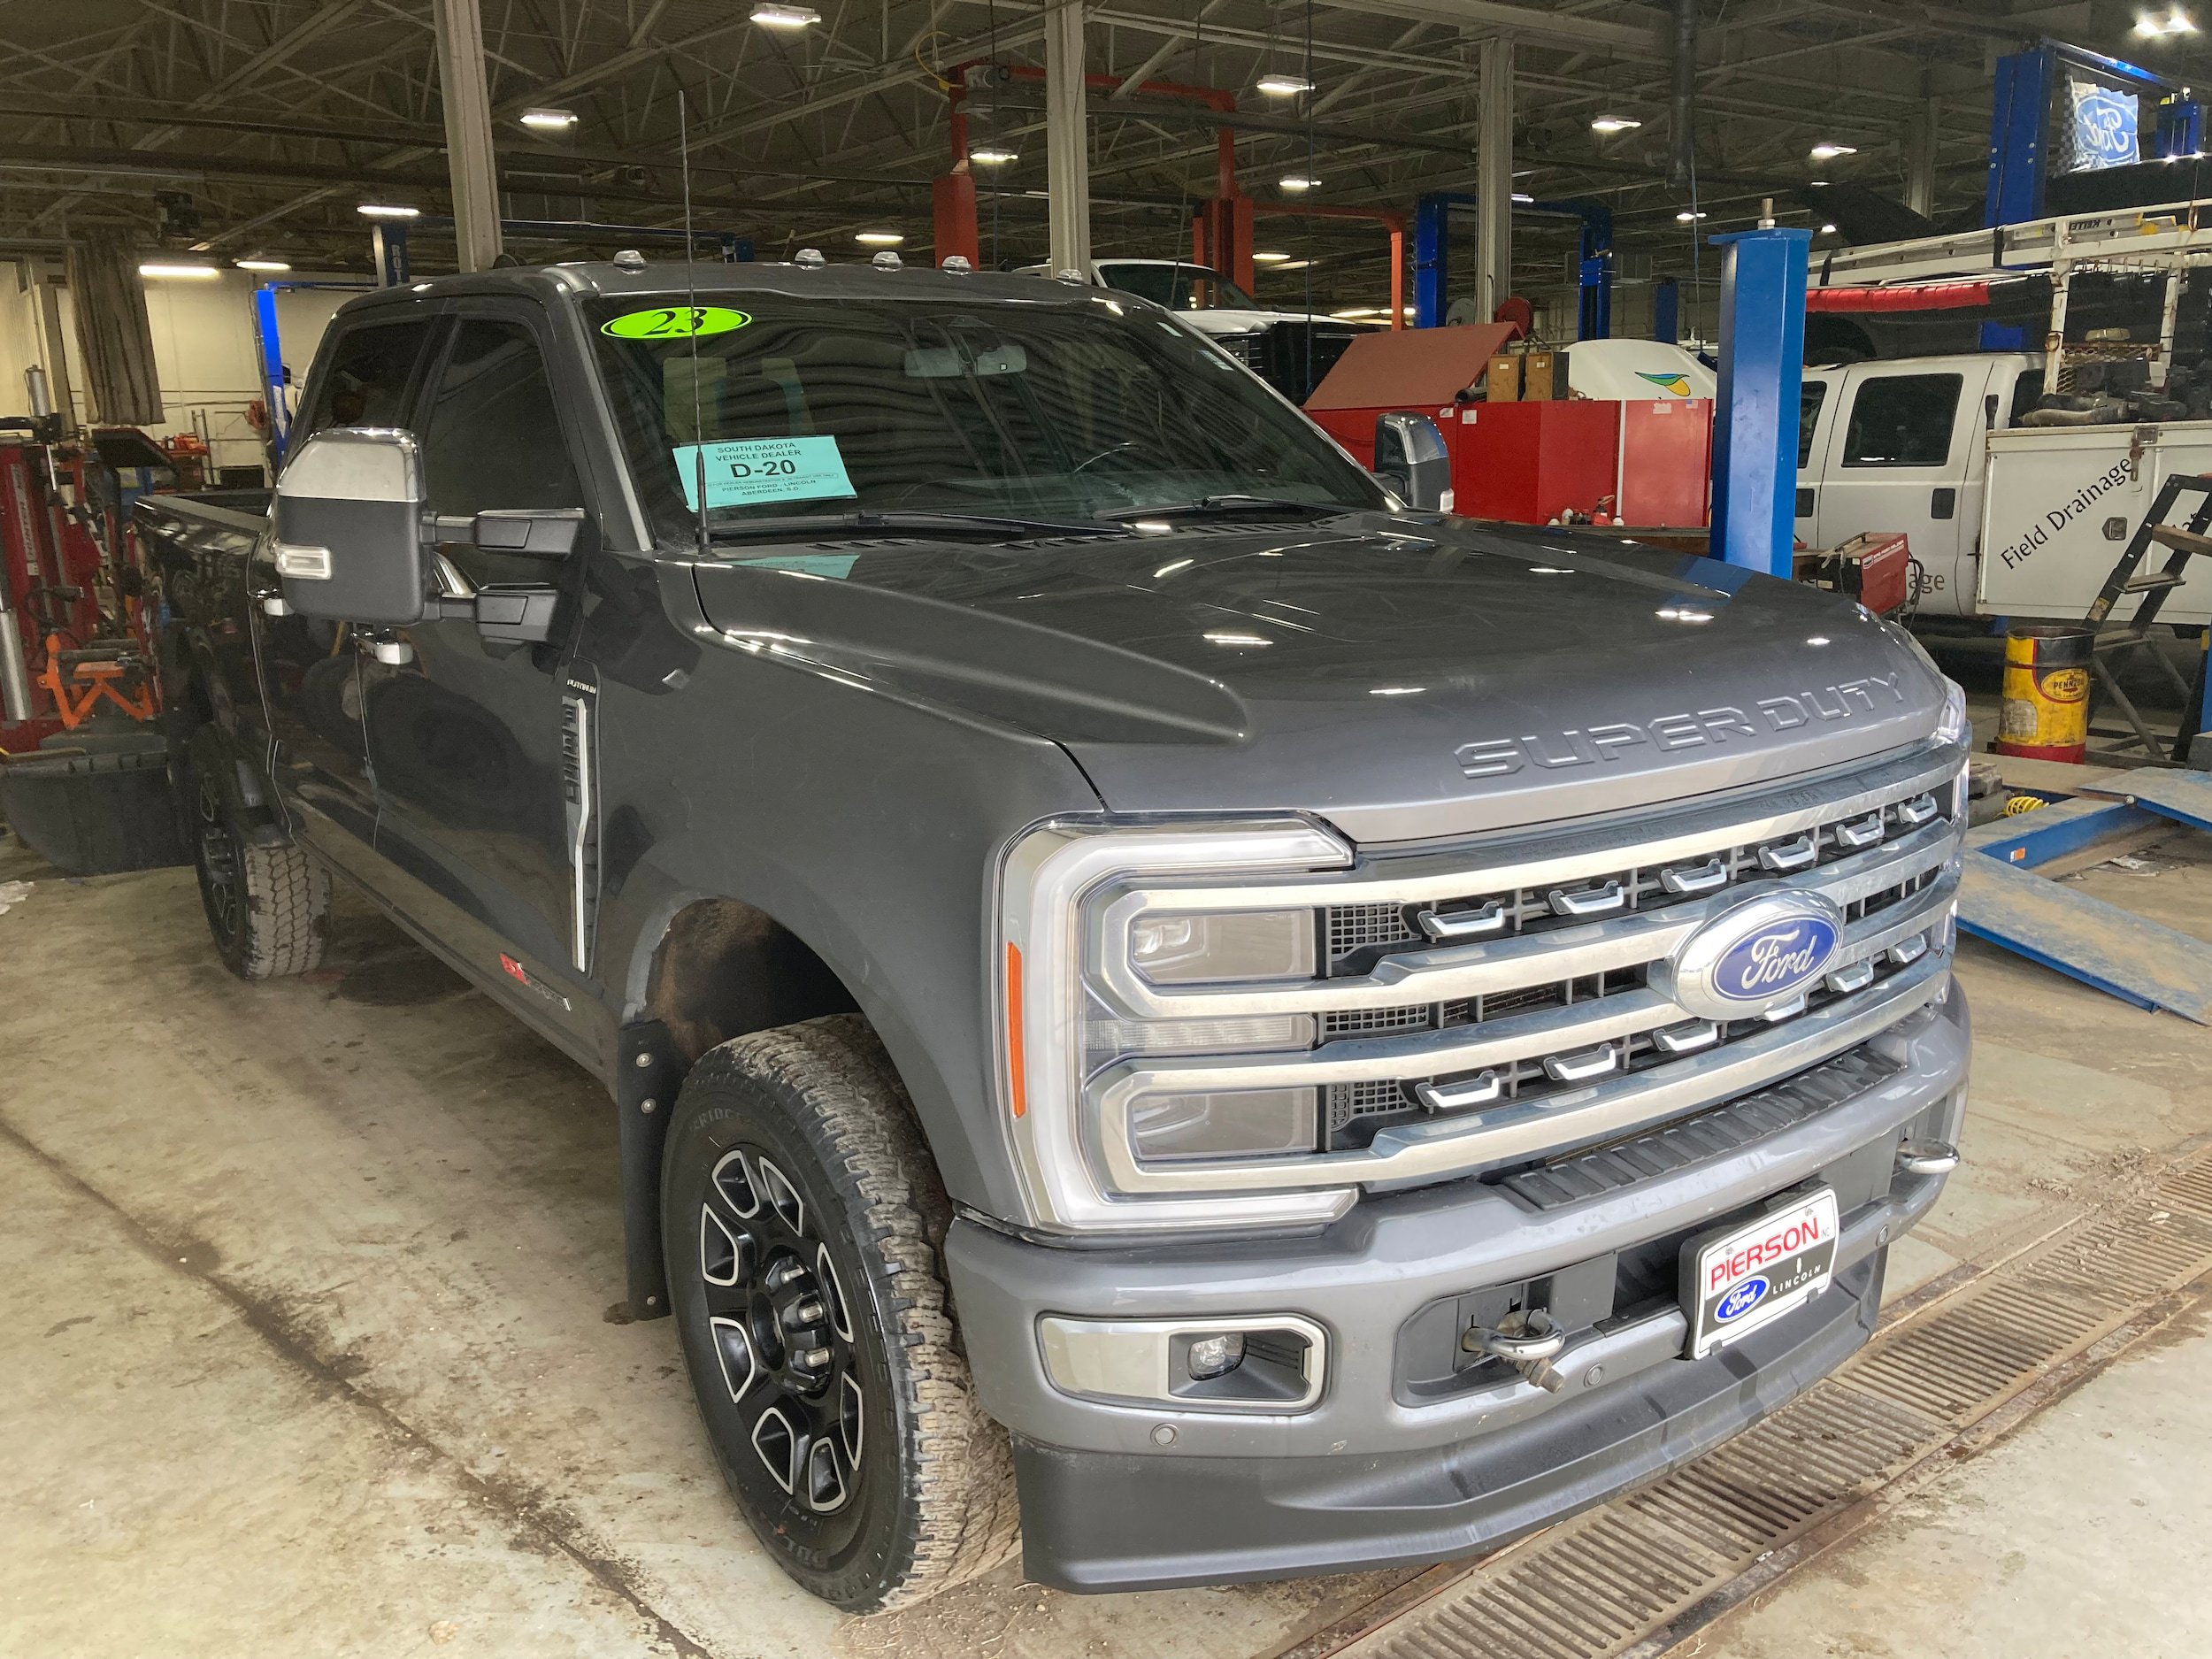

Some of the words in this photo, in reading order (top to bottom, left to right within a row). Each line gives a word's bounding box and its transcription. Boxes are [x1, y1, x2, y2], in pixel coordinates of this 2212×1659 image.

[642, 308, 708, 336] 23
[718, 445, 752, 454] SOUTH
[755, 442, 796, 451] DAKOTA
[730, 459, 796, 478] D-20
[761, 449, 802, 458] DEALER
[2001, 524, 2048, 570] Field
[2046, 458, 2132, 531] Drainage
[2053, 679, 2085, 689] PENNZO
[1453, 705, 1757, 780] SUPER
[1757, 672, 1904, 732] DUTY
[1740, 926, 1818, 990] Ford
[1710, 1217, 1820, 1292] PIERSON
[1725, 1284, 1757, 1317] Ford
[1772, 1263, 1821, 1295] LINCOLN
